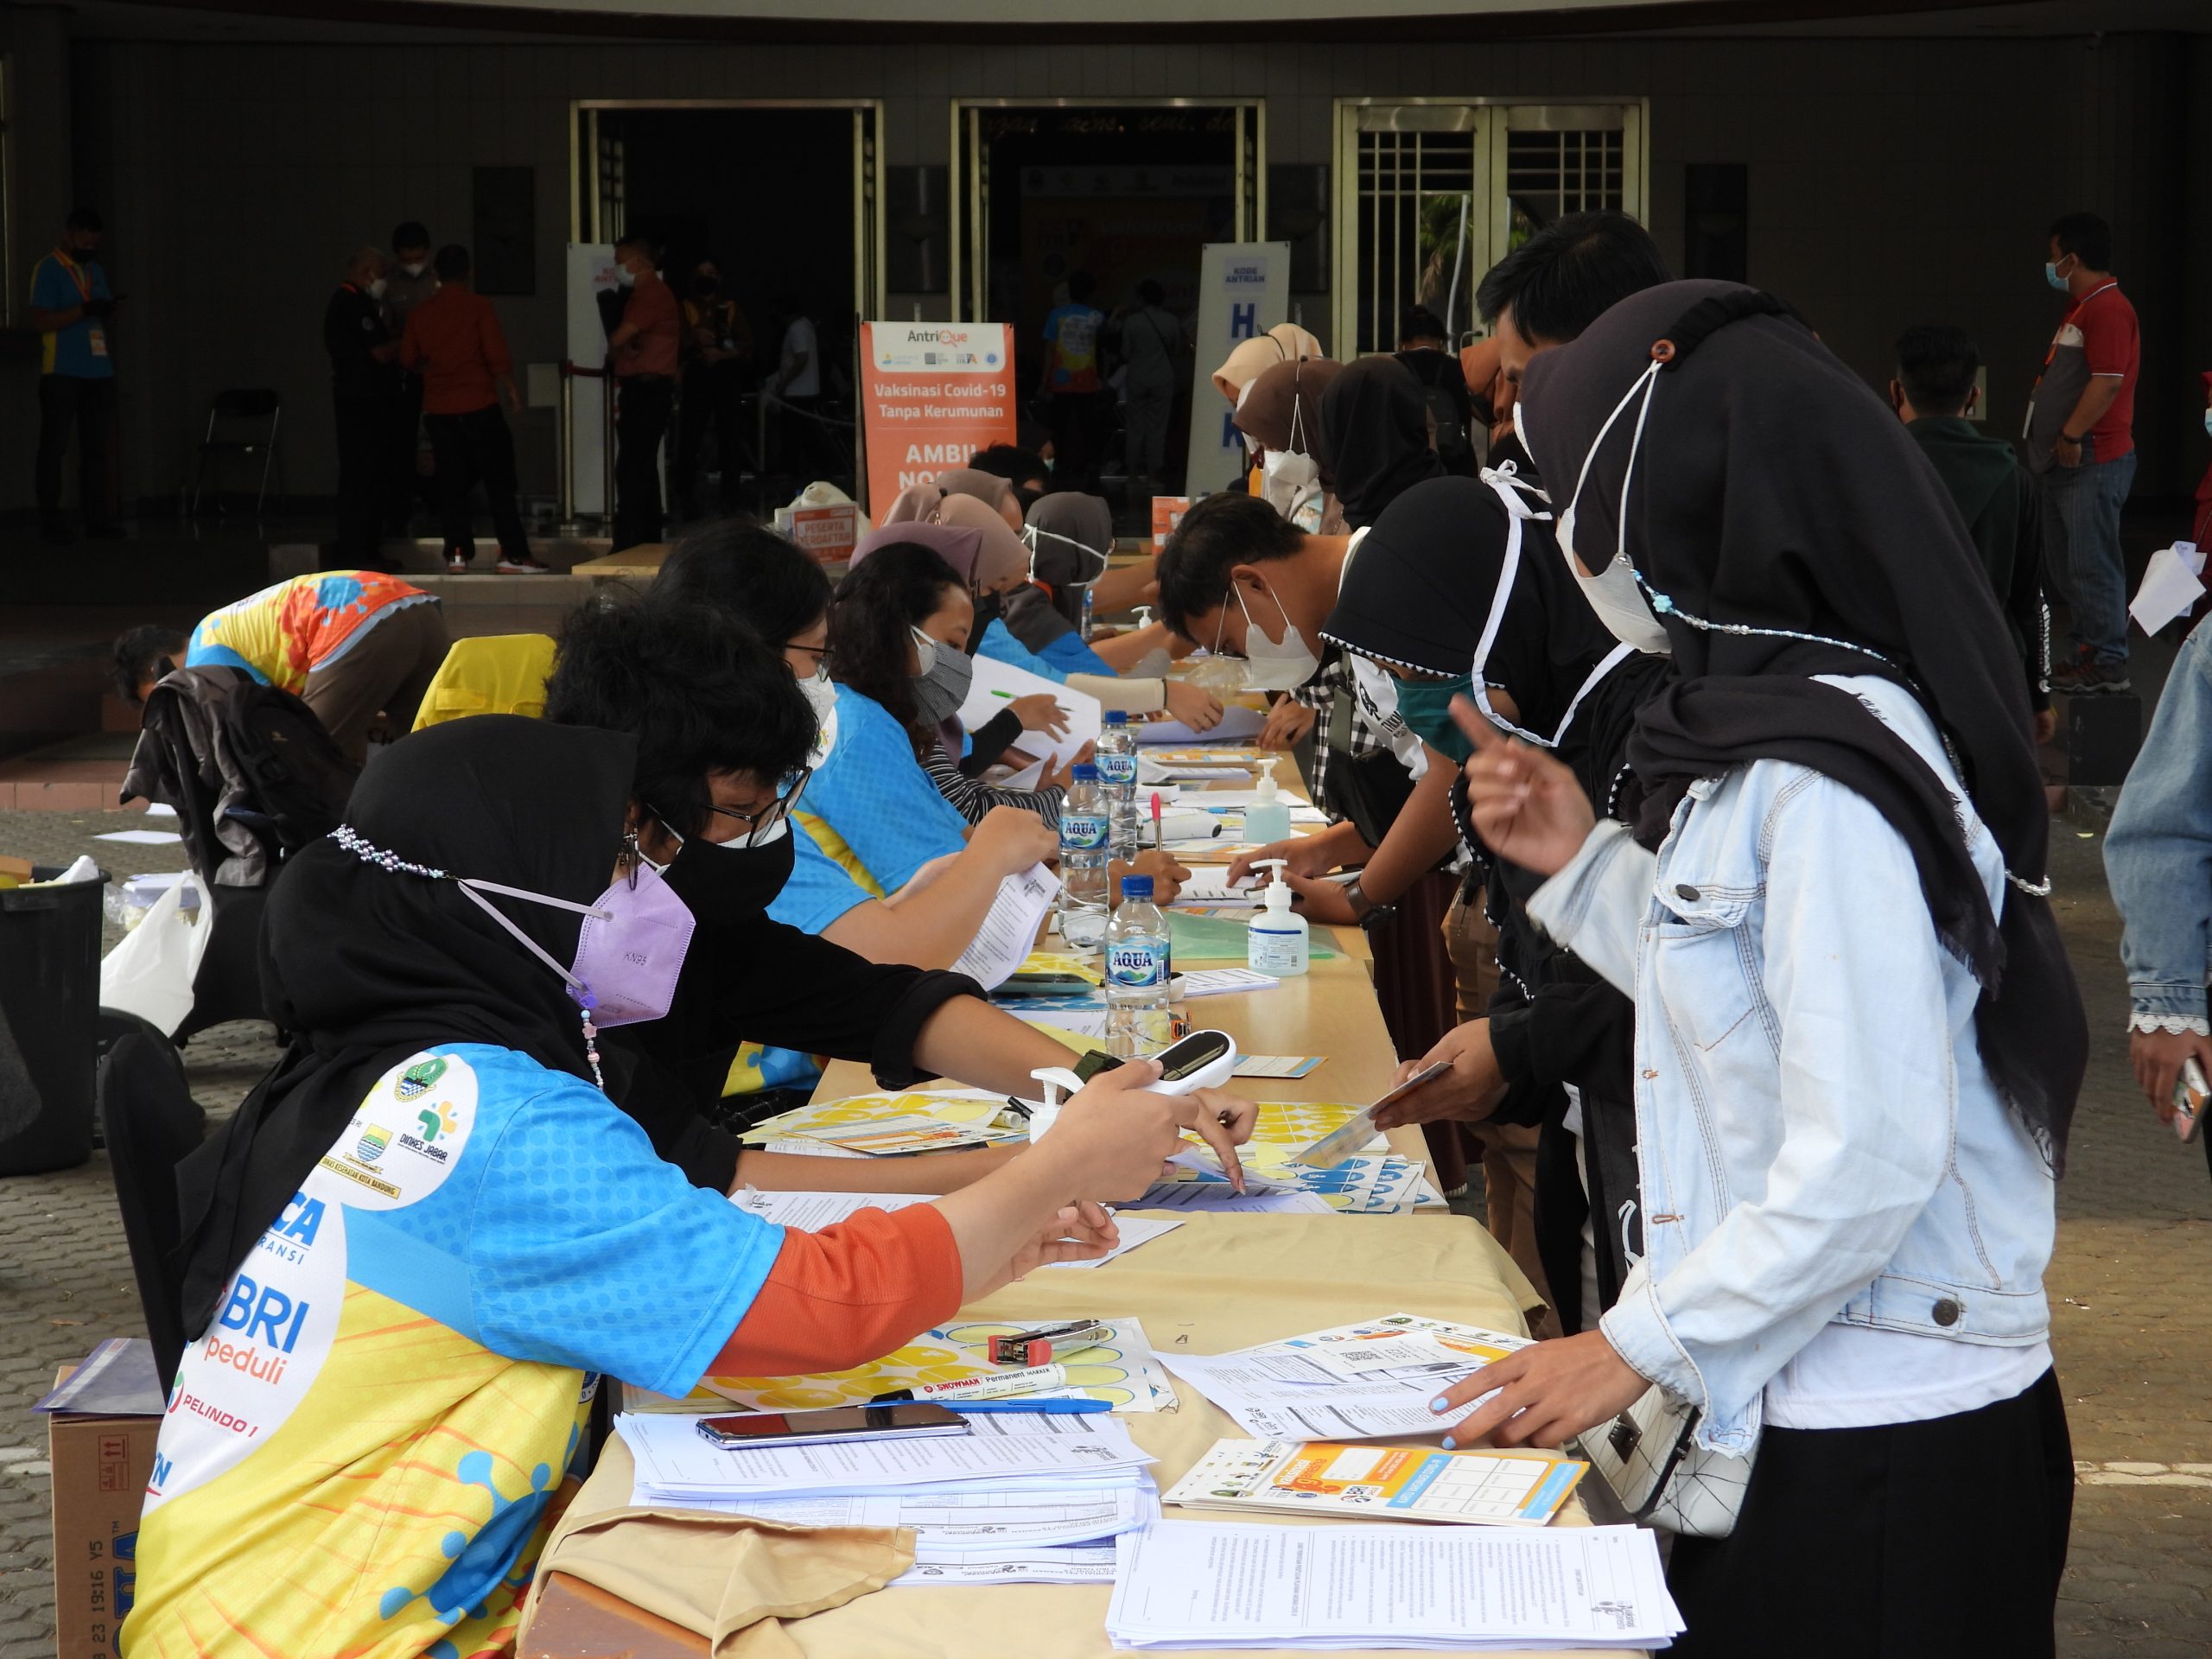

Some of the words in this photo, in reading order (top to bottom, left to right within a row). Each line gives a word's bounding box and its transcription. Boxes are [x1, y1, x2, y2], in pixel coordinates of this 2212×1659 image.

[1225, 274, 1265, 283] ANTRIAN
[1231, 303, 1255, 338] H
[907, 329, 969, 347] AntriQue
[874, 383, 941, 397] Vaksinasi
[944, 383, 1007, 397] Covid-19
[879, 404, 921, 420] Tanpa
[924, 404, 1003, 418] Kerumunan
[1107, 760, 1133, 772] AQUA
[1065, 822, 1096, 837] AQUA
[624, 950, 647, 966] KN95
[1112, 950, 1153, 969] AQUA
[399, 1133, 424, 1151] DINKES
[423, 1143, 448, 1162] JABAR
[334, 1162, 359, 1180] KESEHATAN
[358, 1173, 372, 1185] KOTA
[371, 1178, 395, 1196] BANDUNG
[219, 1274, 309, 1354] BRI
[204, 1335, 289, 1386] peduli
[936, 1377, 981, 1392] SNOWMAN
[985, 1371, 1026, 1383] Permanent
[1027, 1367, 1052, 1378] MARKER
[183, 1394, 247, 1433] PELINDO
[248, 1425, 260, 1439] 1
[152, 1452, 173, 1488] N
[89, 1541, 104, 1560] Y5
[90, 1570, 105, 1612] 19:16
[92, 1623, 105, 1643] 23
